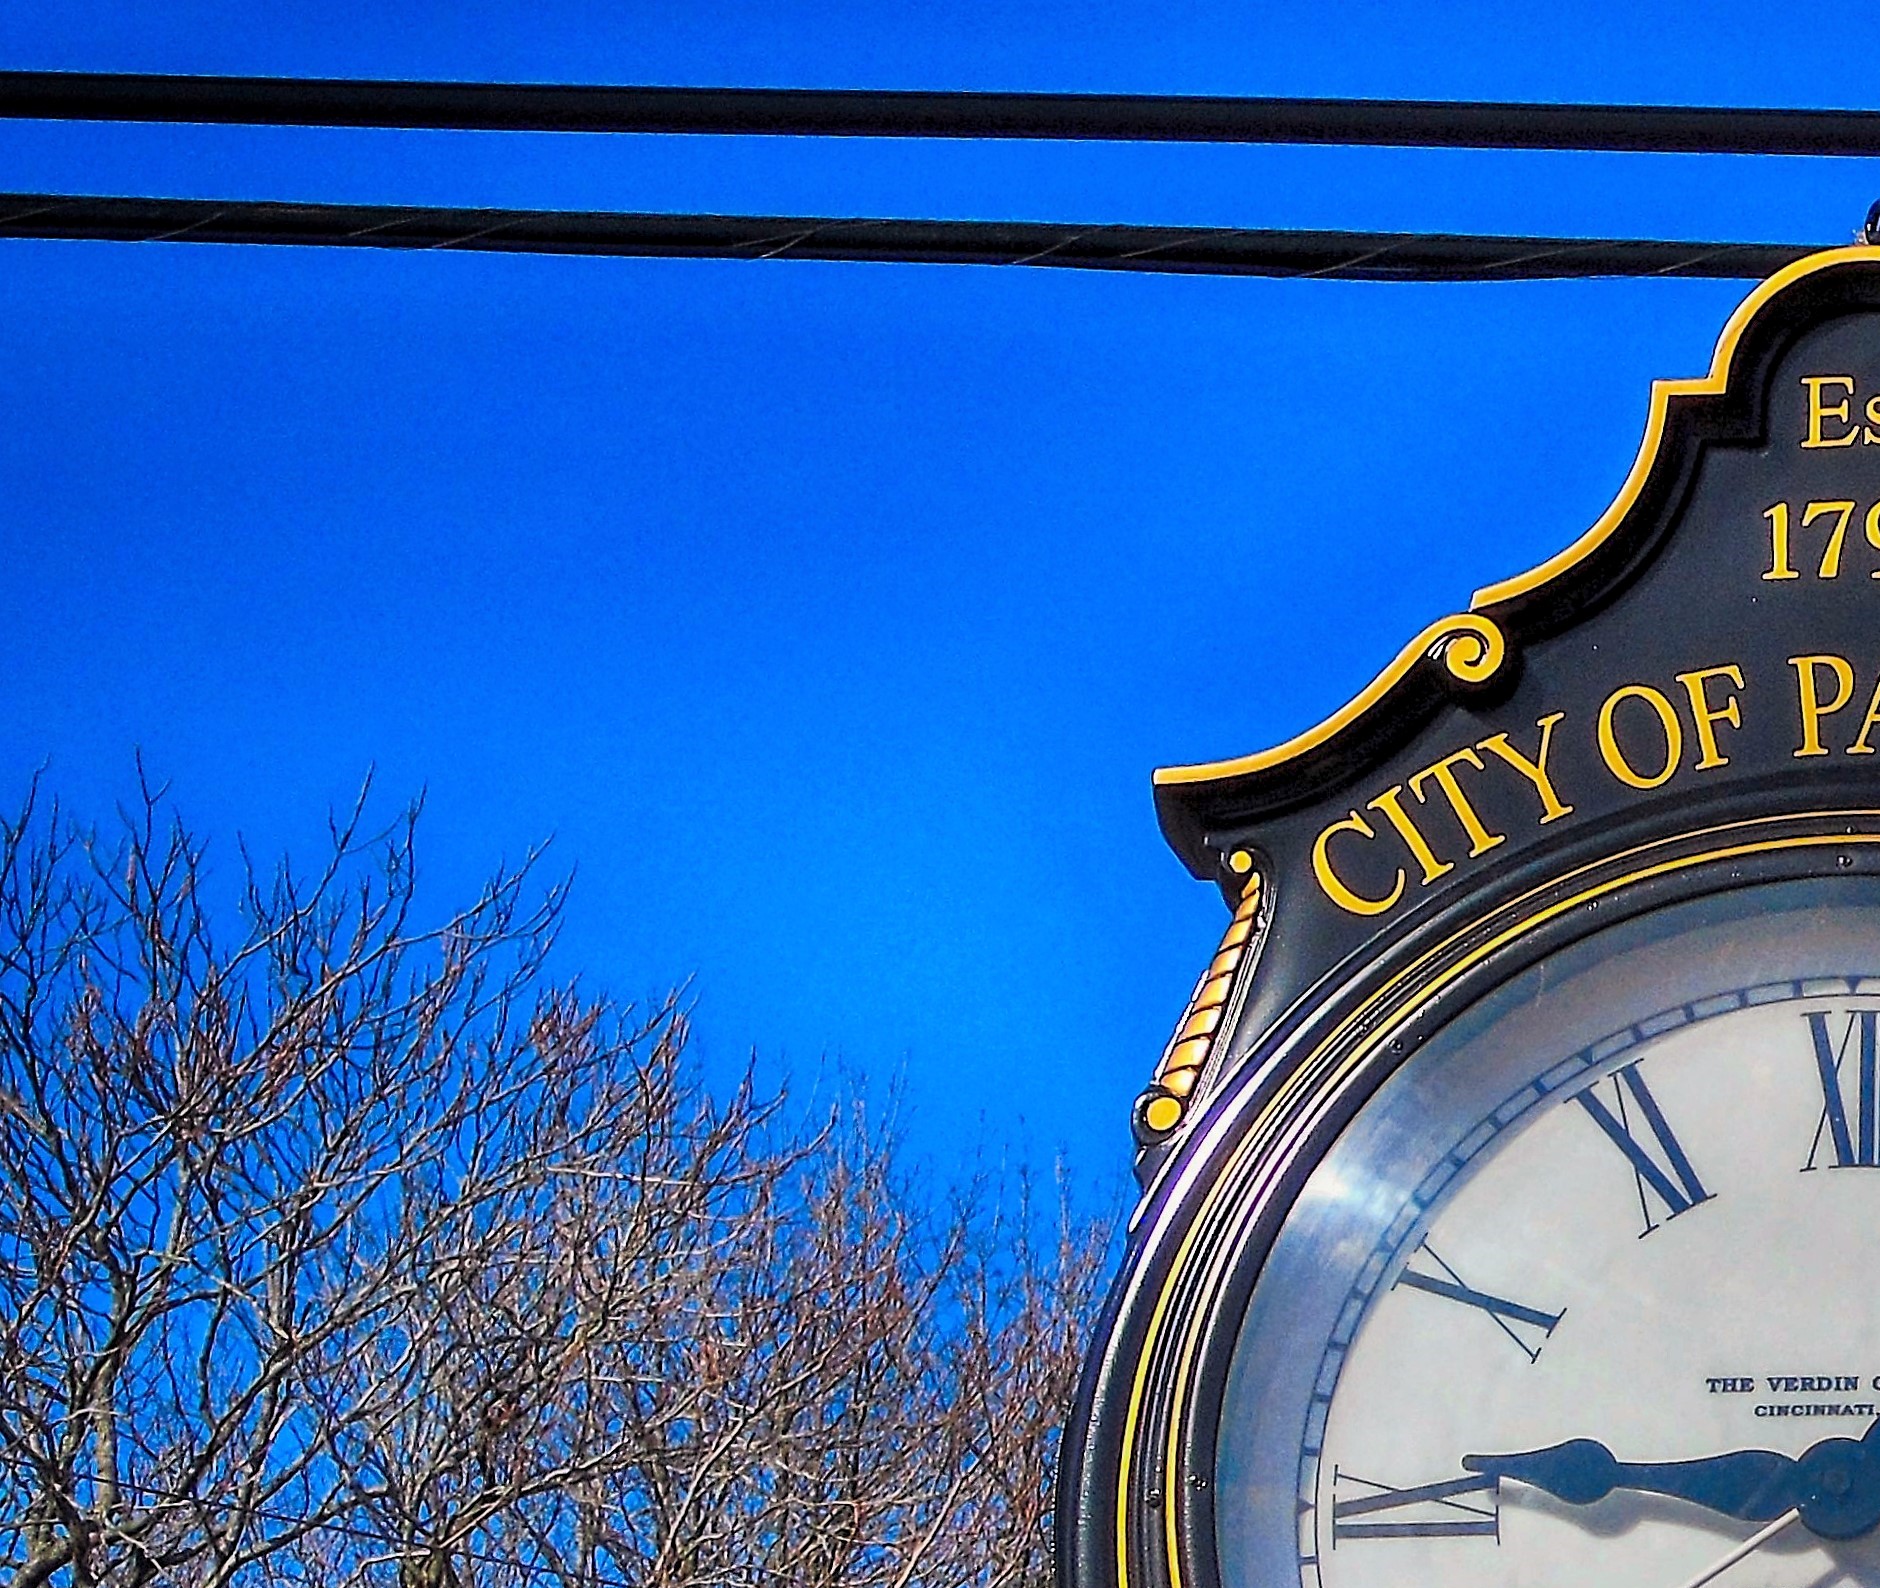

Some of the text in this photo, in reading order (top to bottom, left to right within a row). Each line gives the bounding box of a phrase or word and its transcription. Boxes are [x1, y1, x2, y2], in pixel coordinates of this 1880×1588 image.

[1310, 712, 1574, 917] CITY
[1597, 664, 1746, 791] OF
[1563, 1058, 1718, 1240] XI
[1390, 1231, 1568, 1365] X
[1705, 1377, 1755, 1393] THE
[1766, 1376, 1860, 1392] VERDIN
